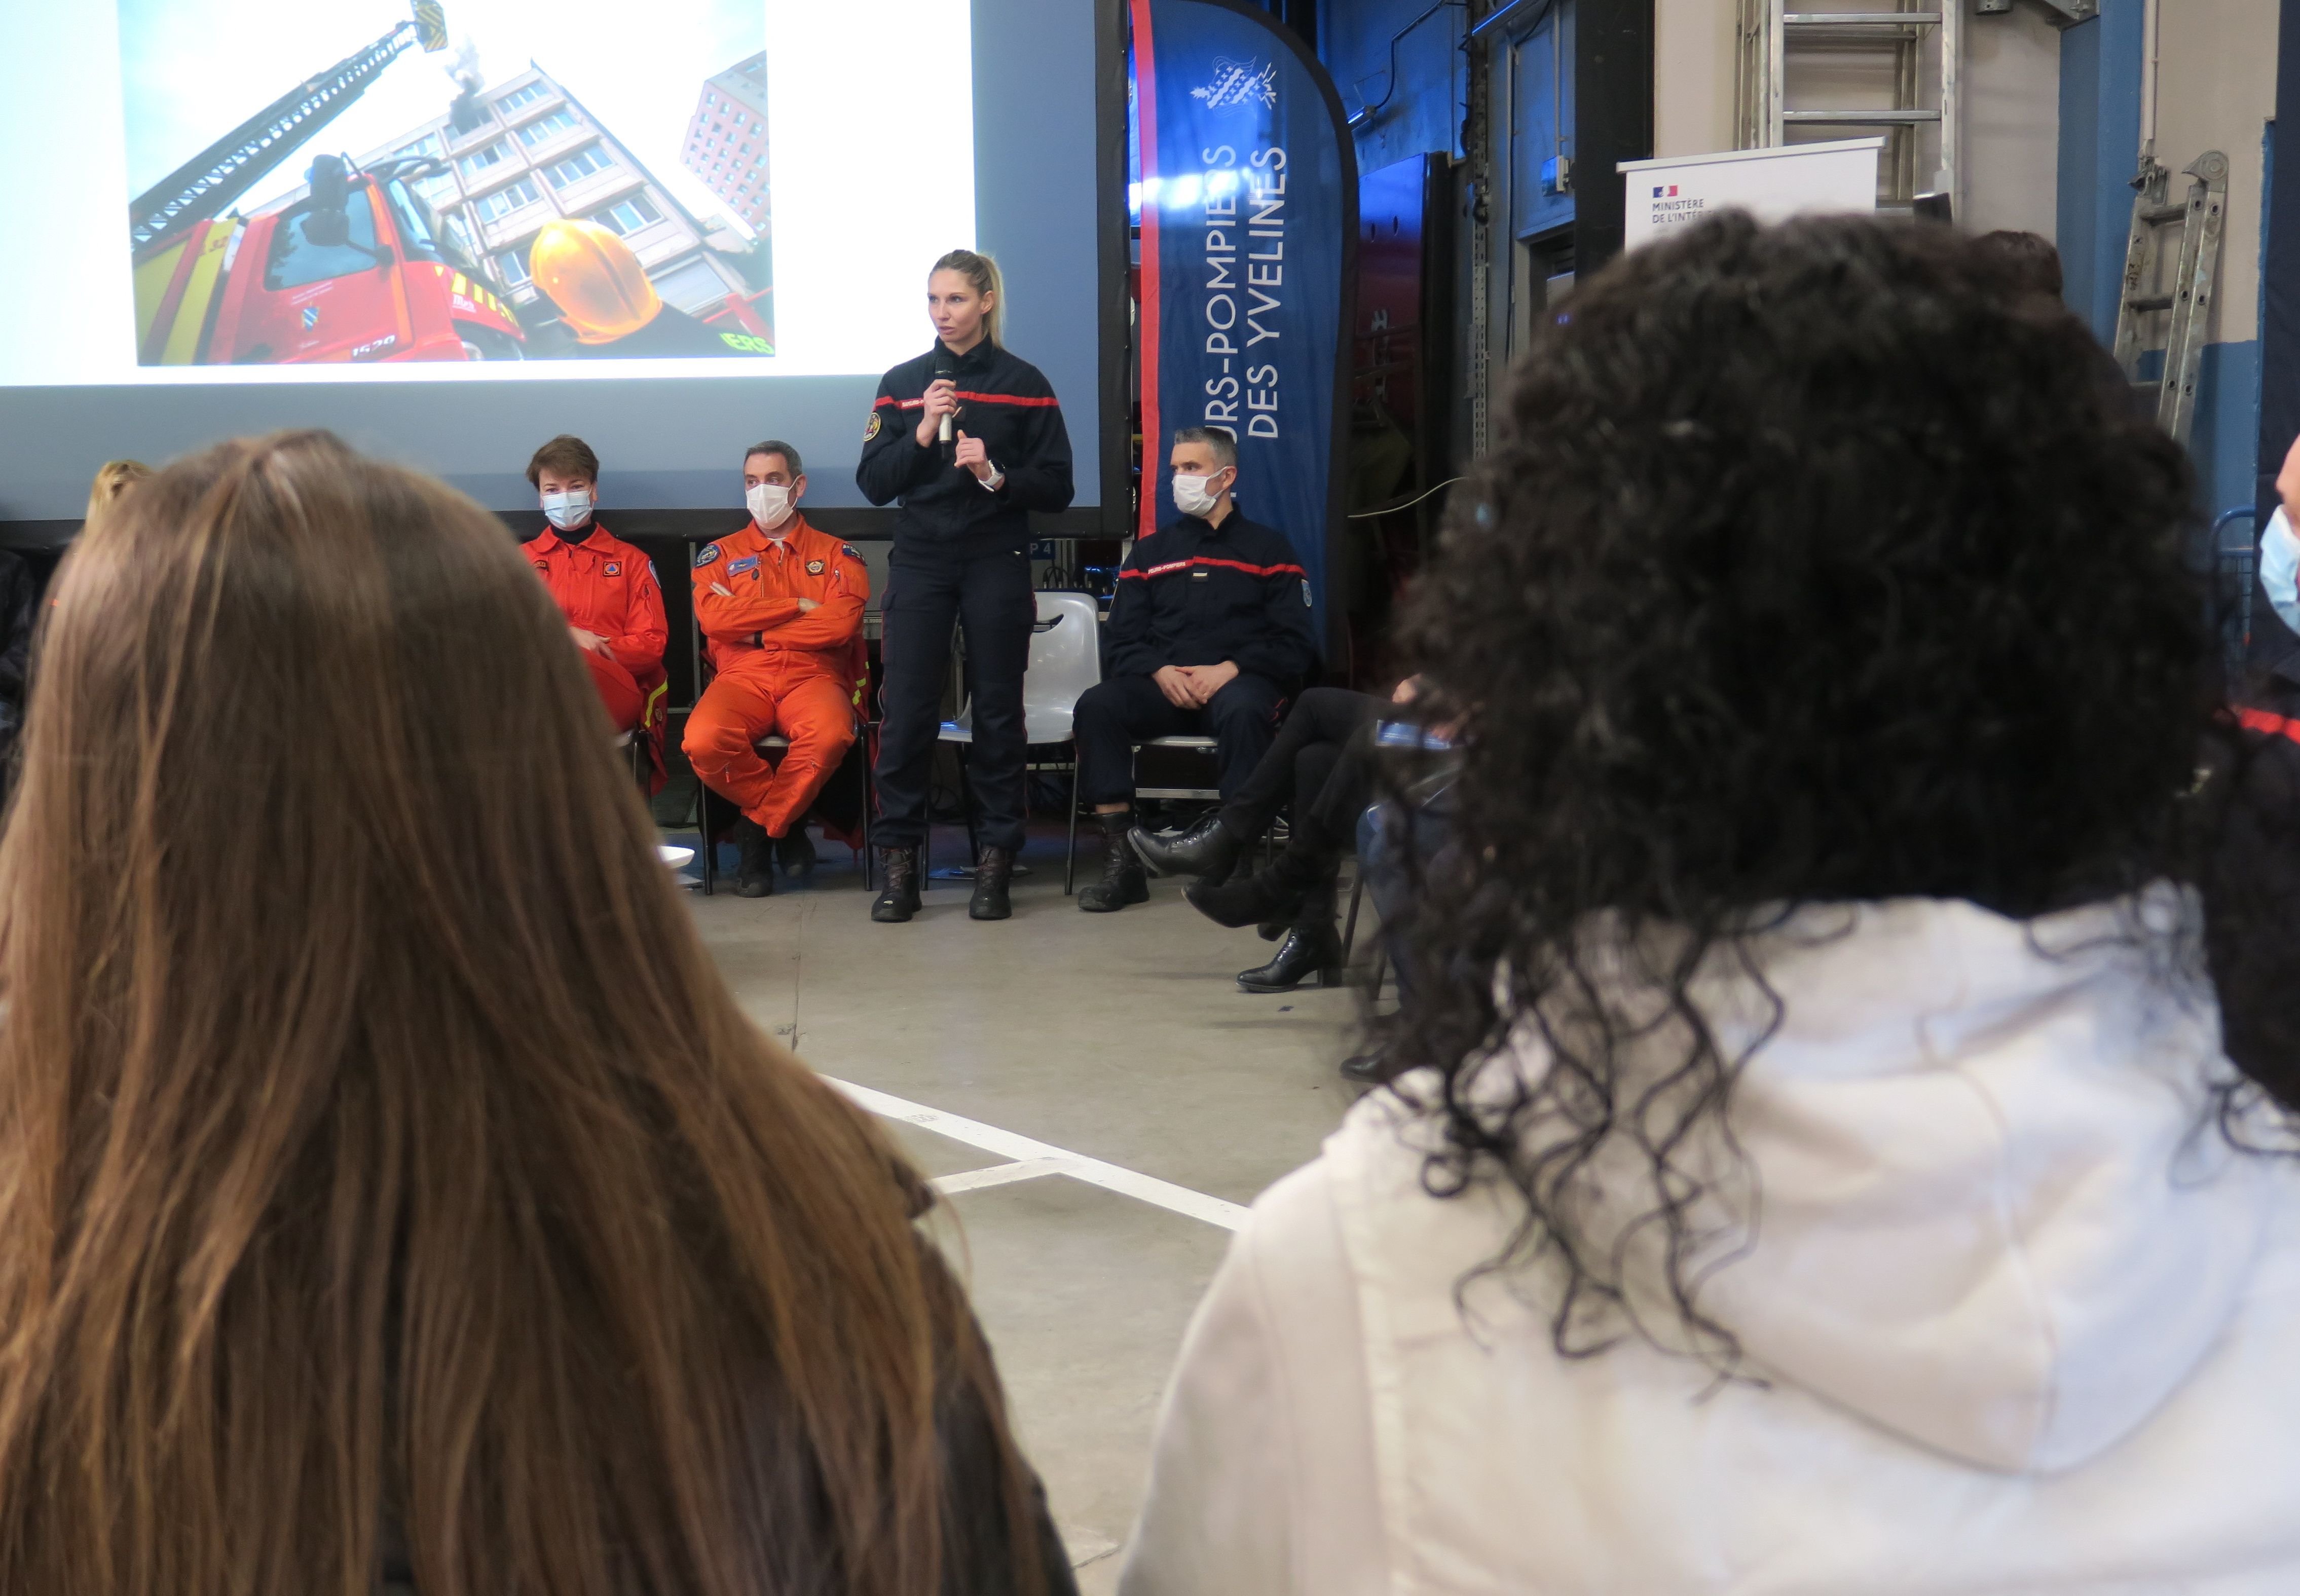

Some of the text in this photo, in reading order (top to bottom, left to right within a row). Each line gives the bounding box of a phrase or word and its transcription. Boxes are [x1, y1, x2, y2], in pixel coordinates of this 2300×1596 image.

[1652, 198, 1704, 211] MINISTÈRE
[1652, 213, 1665, 223] DE
[1246, 147, 1287, 438] DES YVELINES
